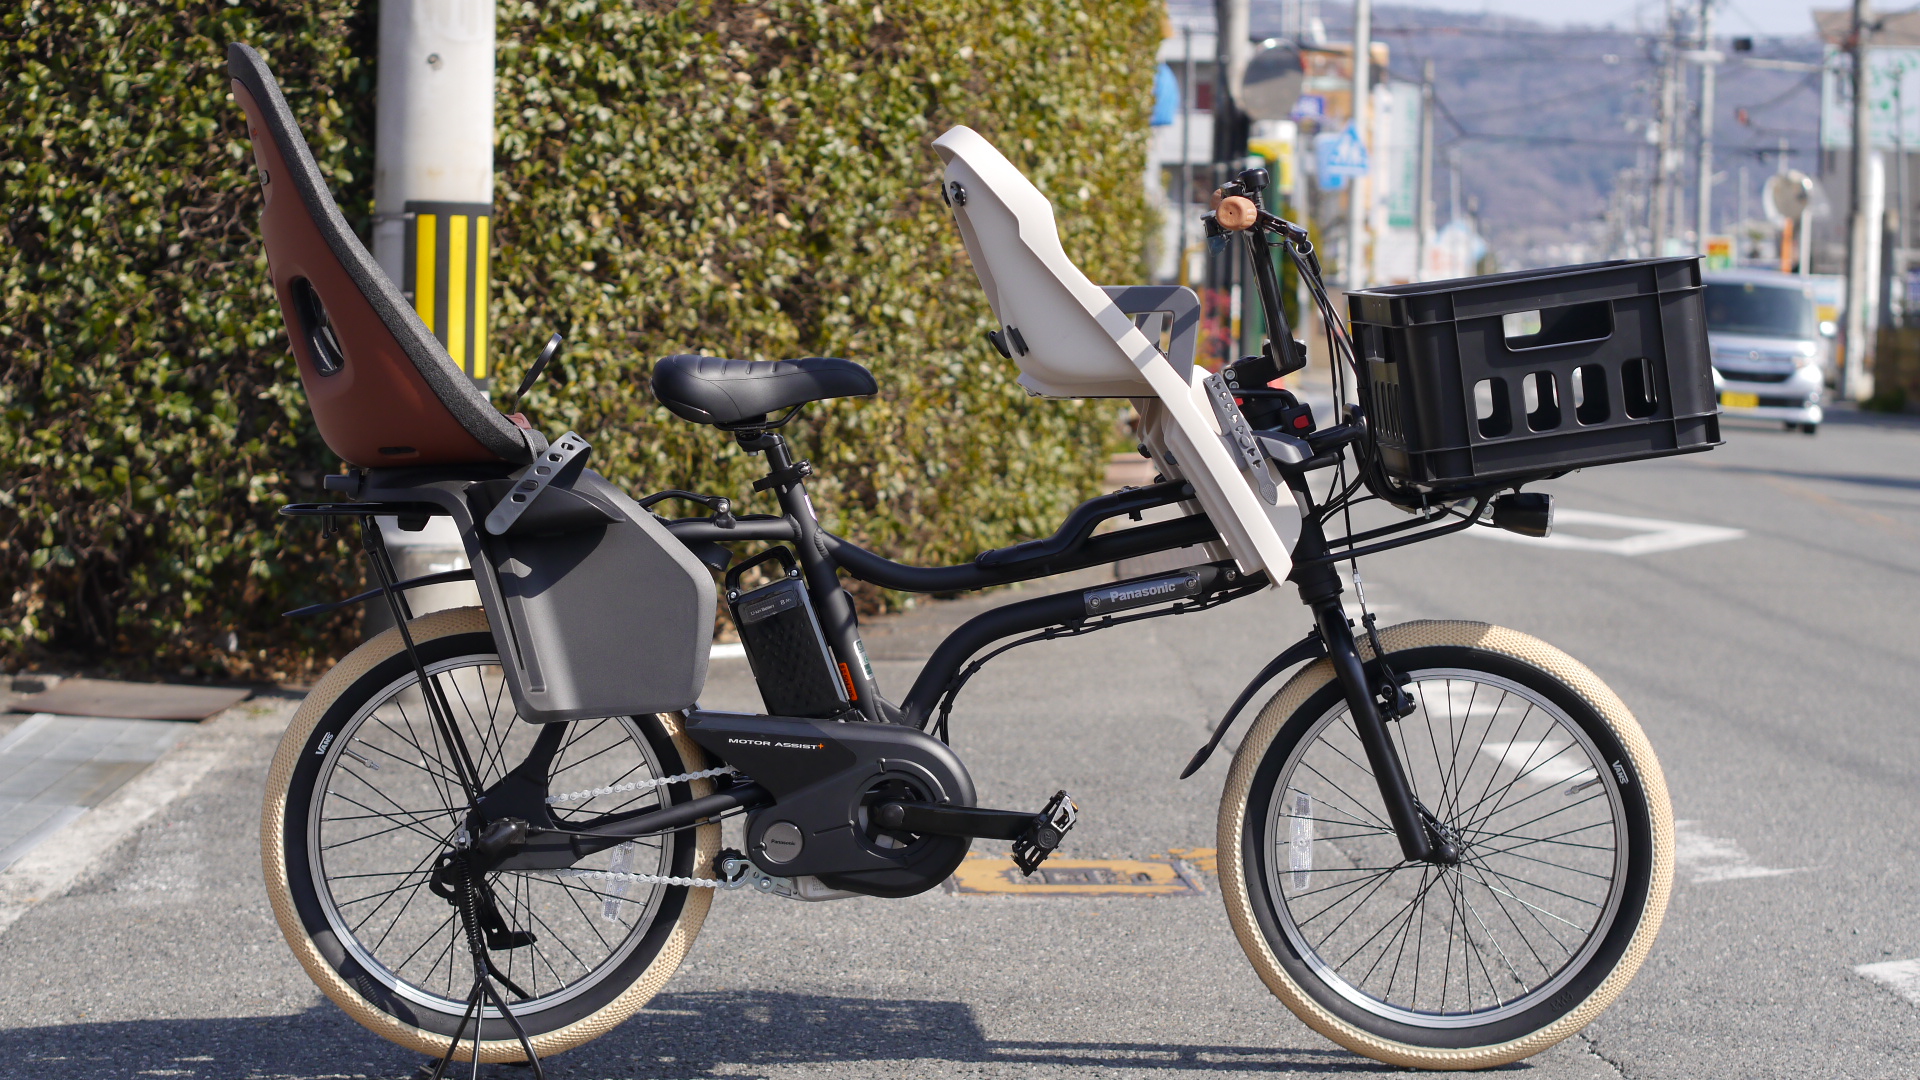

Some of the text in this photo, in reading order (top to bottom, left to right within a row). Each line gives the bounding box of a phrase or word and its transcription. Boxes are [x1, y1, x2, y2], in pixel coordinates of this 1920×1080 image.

[1110, 582, 1175, 603] Panasonic
[315, 732, 333, 754] VANS
[729, 738, 770, 746] MOTOR
[1612, 760, 1629, 784] VANS
